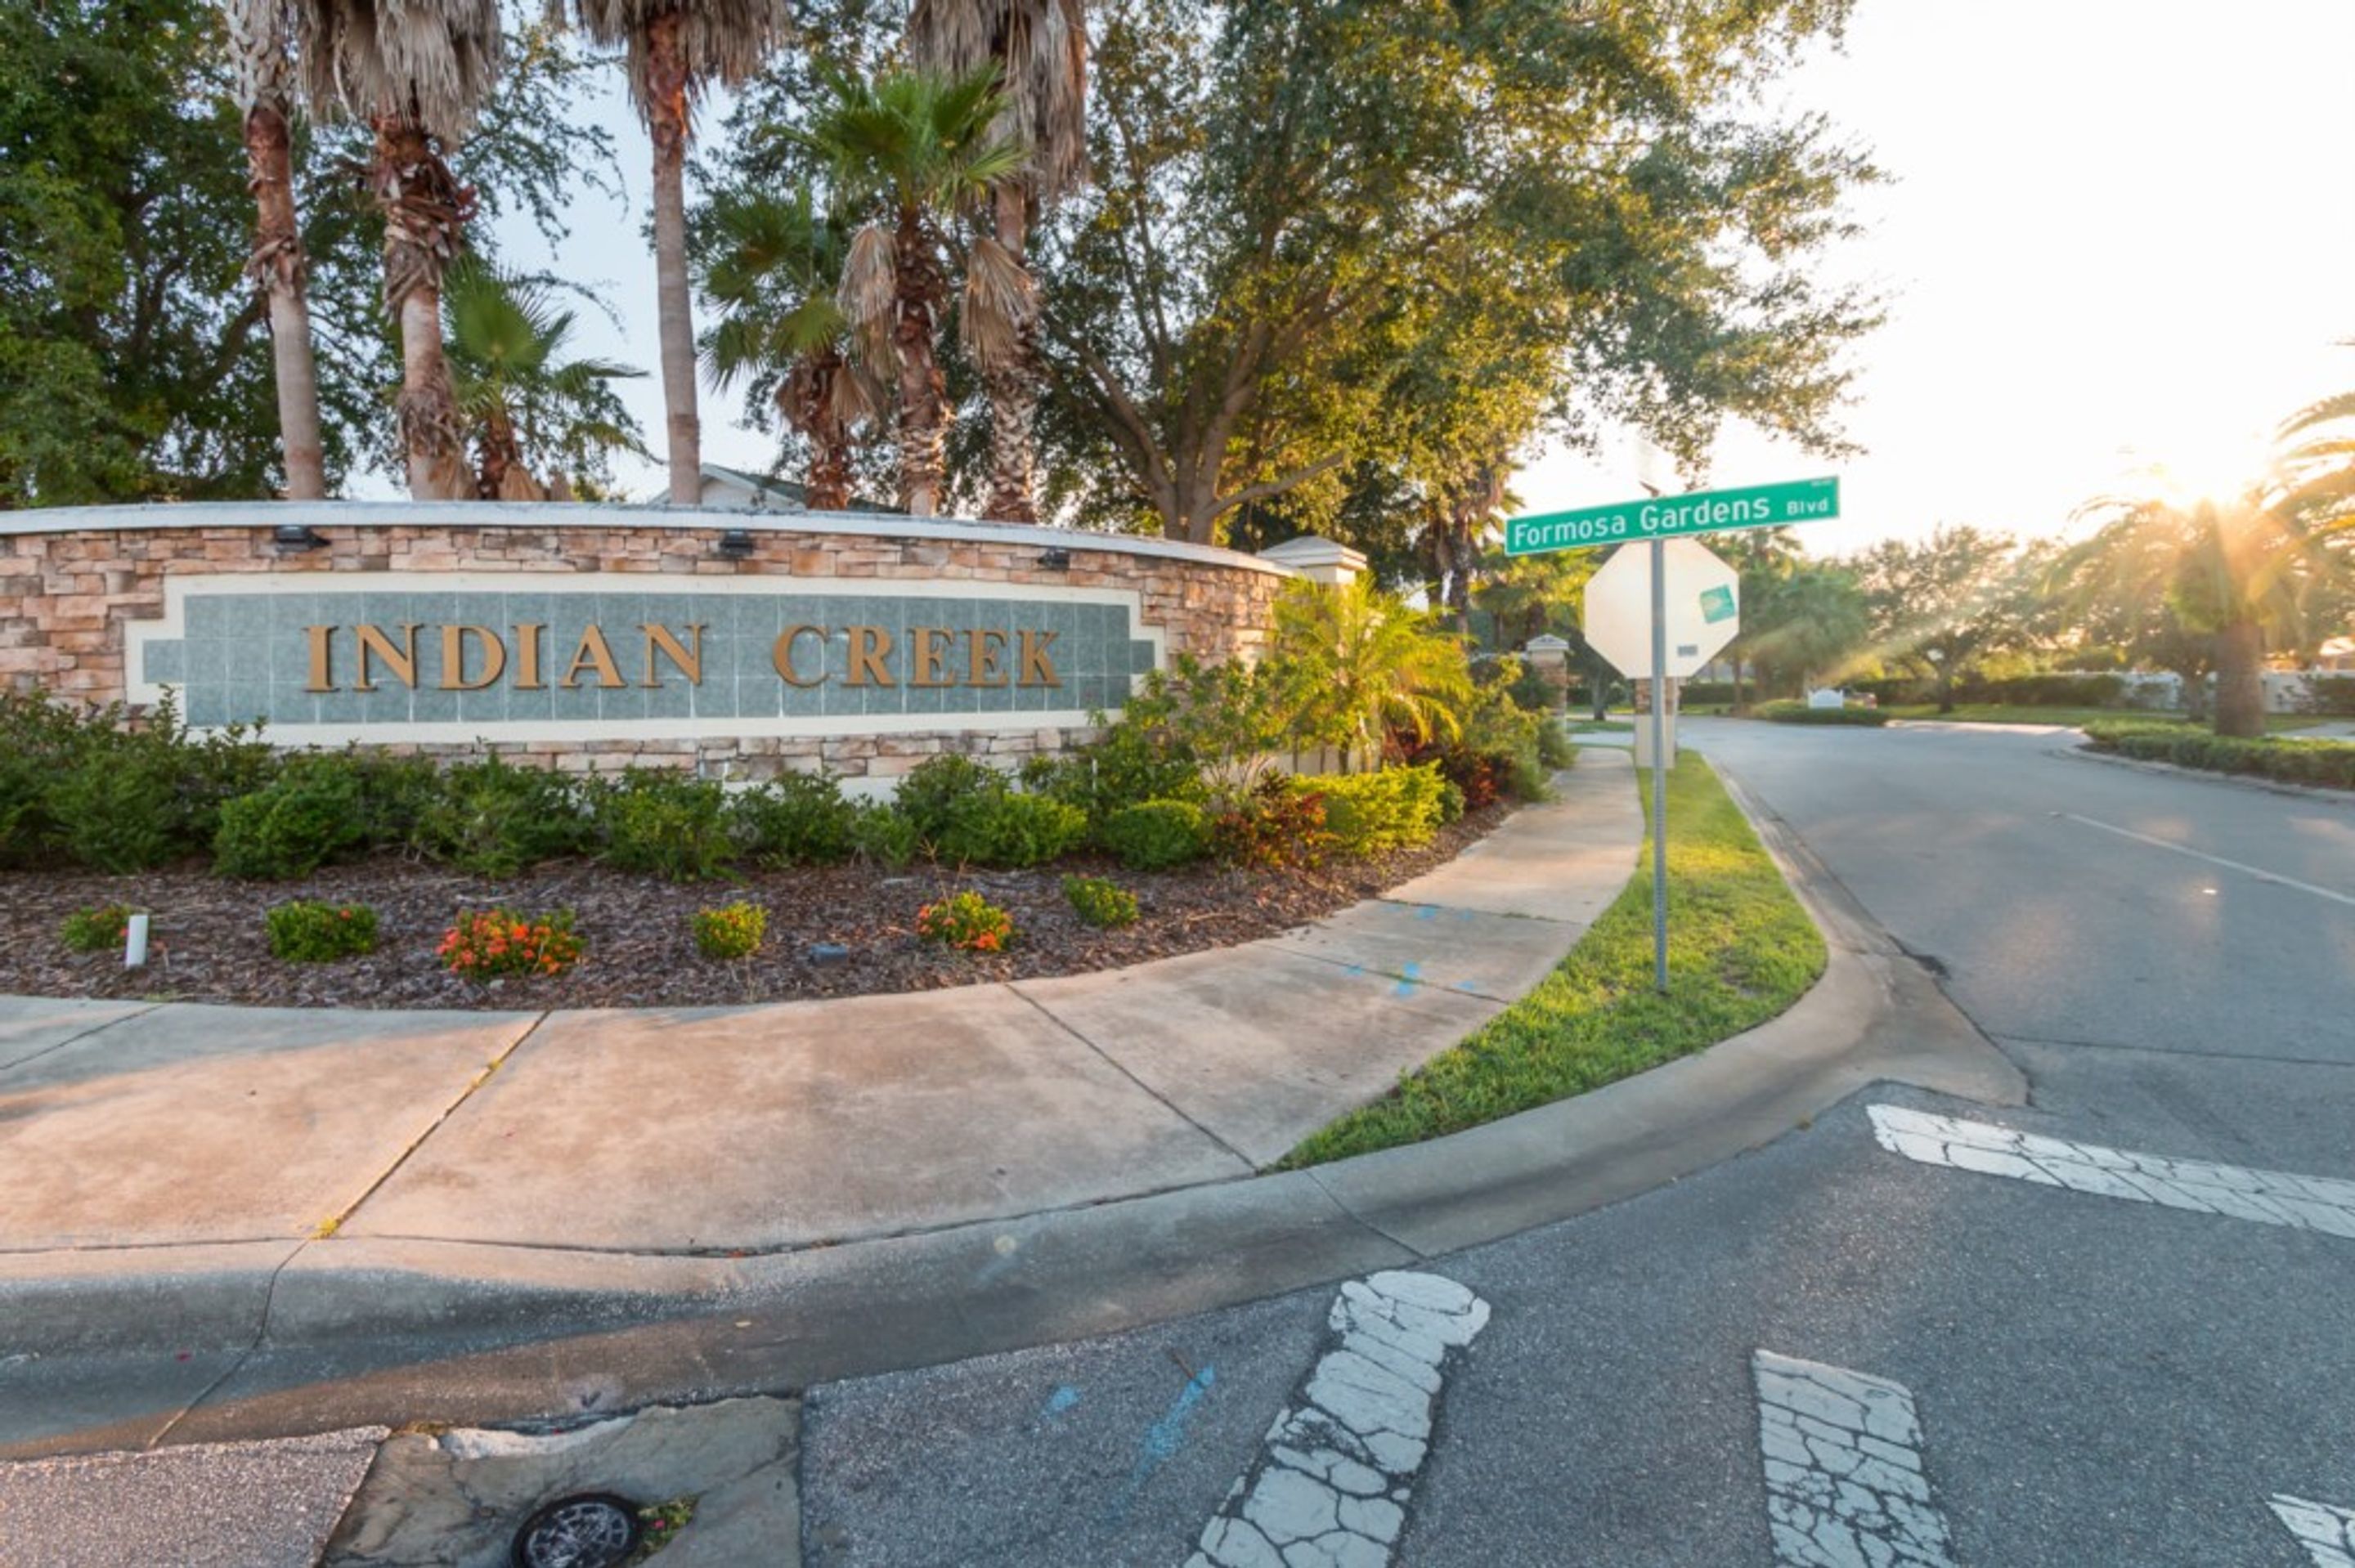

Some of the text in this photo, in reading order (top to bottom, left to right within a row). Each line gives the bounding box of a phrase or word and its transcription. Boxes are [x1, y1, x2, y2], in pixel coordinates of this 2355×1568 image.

[1514, 496, 1829, 547] Formosa Gardens Blvd
[303, 623, 1065, 693] INDIAN CREEK
